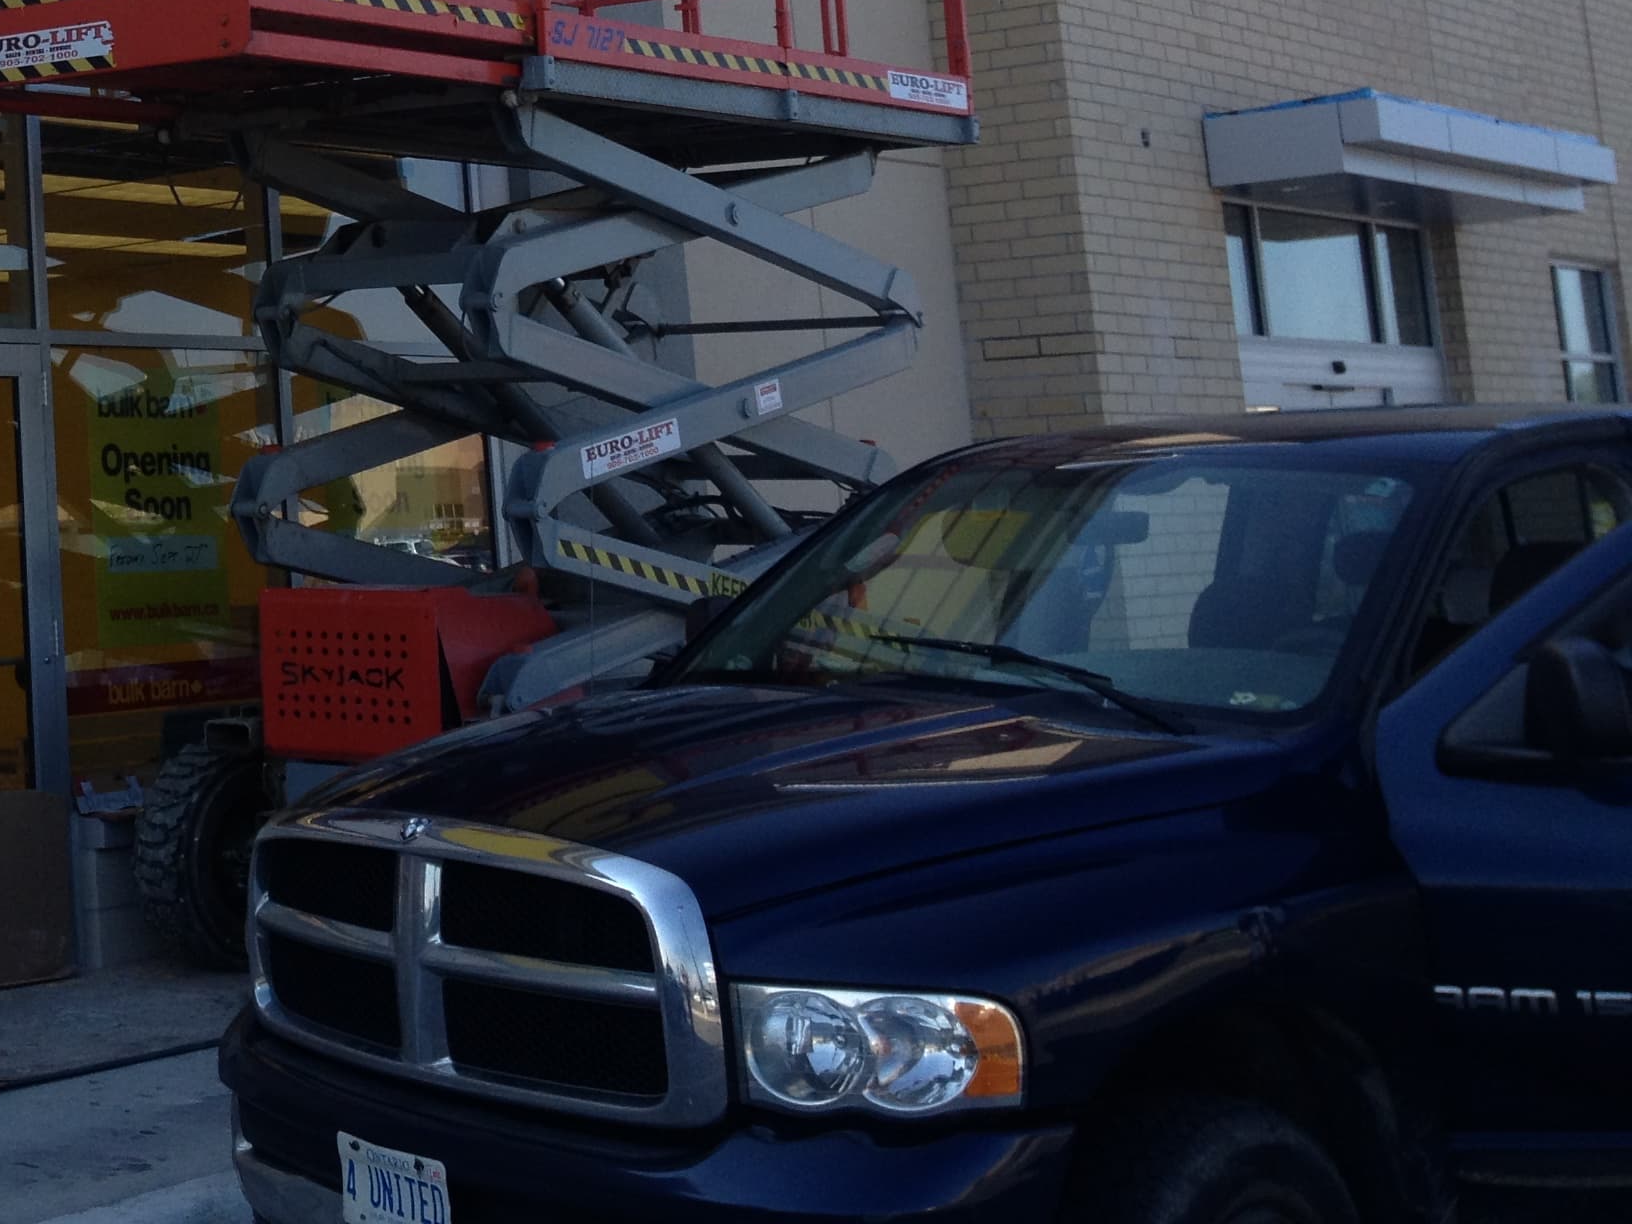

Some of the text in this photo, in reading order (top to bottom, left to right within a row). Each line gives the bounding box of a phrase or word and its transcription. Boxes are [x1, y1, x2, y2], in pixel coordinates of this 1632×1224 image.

[891, 73, 963, 95] EURO-LIFT
[98, 386, 143, 418] bulk
[586, 421, 674, 462] EURO-LIFT
[101, 443, 211, 484] Opening
[125, 488, 192, 521] Soon
[109, 602, 219, 622] www.bulkbarn.ca
[108, 677, 145, 705] bulk
[150, 676, 190, 701] barn
[281, 662, 405, 691] SKYJACK
[367, 1164, 445, 1224] UNITED
